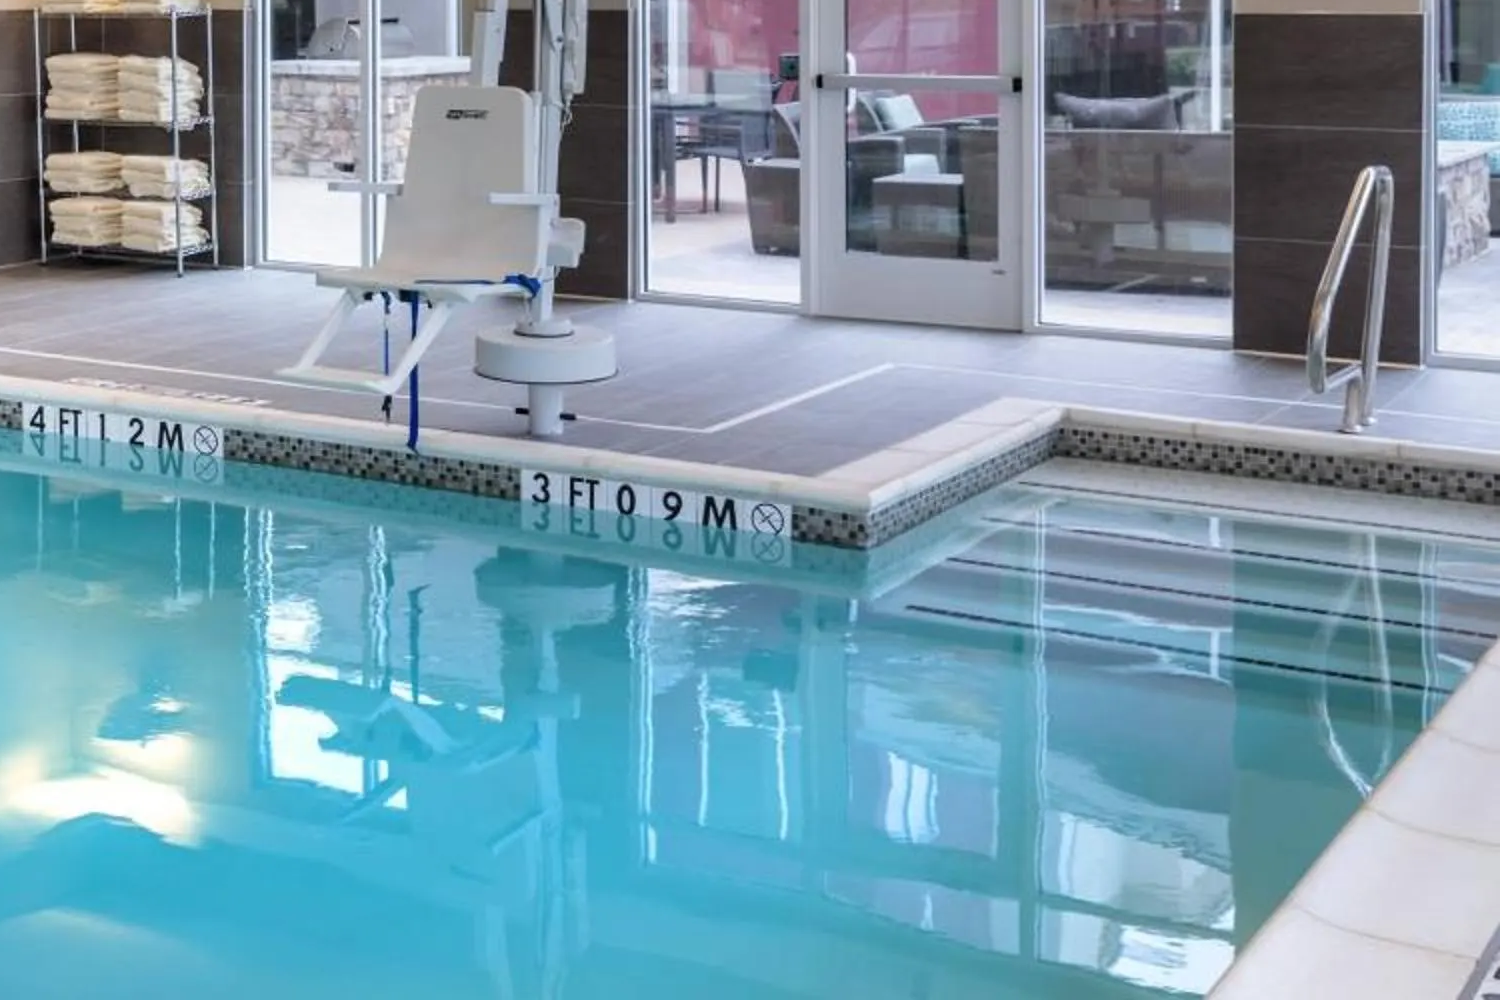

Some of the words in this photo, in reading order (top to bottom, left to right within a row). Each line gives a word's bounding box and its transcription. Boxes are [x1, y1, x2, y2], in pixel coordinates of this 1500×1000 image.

[29, 405, 46, 433] 4
[59, 408, 83, 438] FT
[158, 420, 185, 452] M
[531, 472, 551, 503] 3
[569, 476, 600, 511] FT
[701, 496, 738, 532] M
